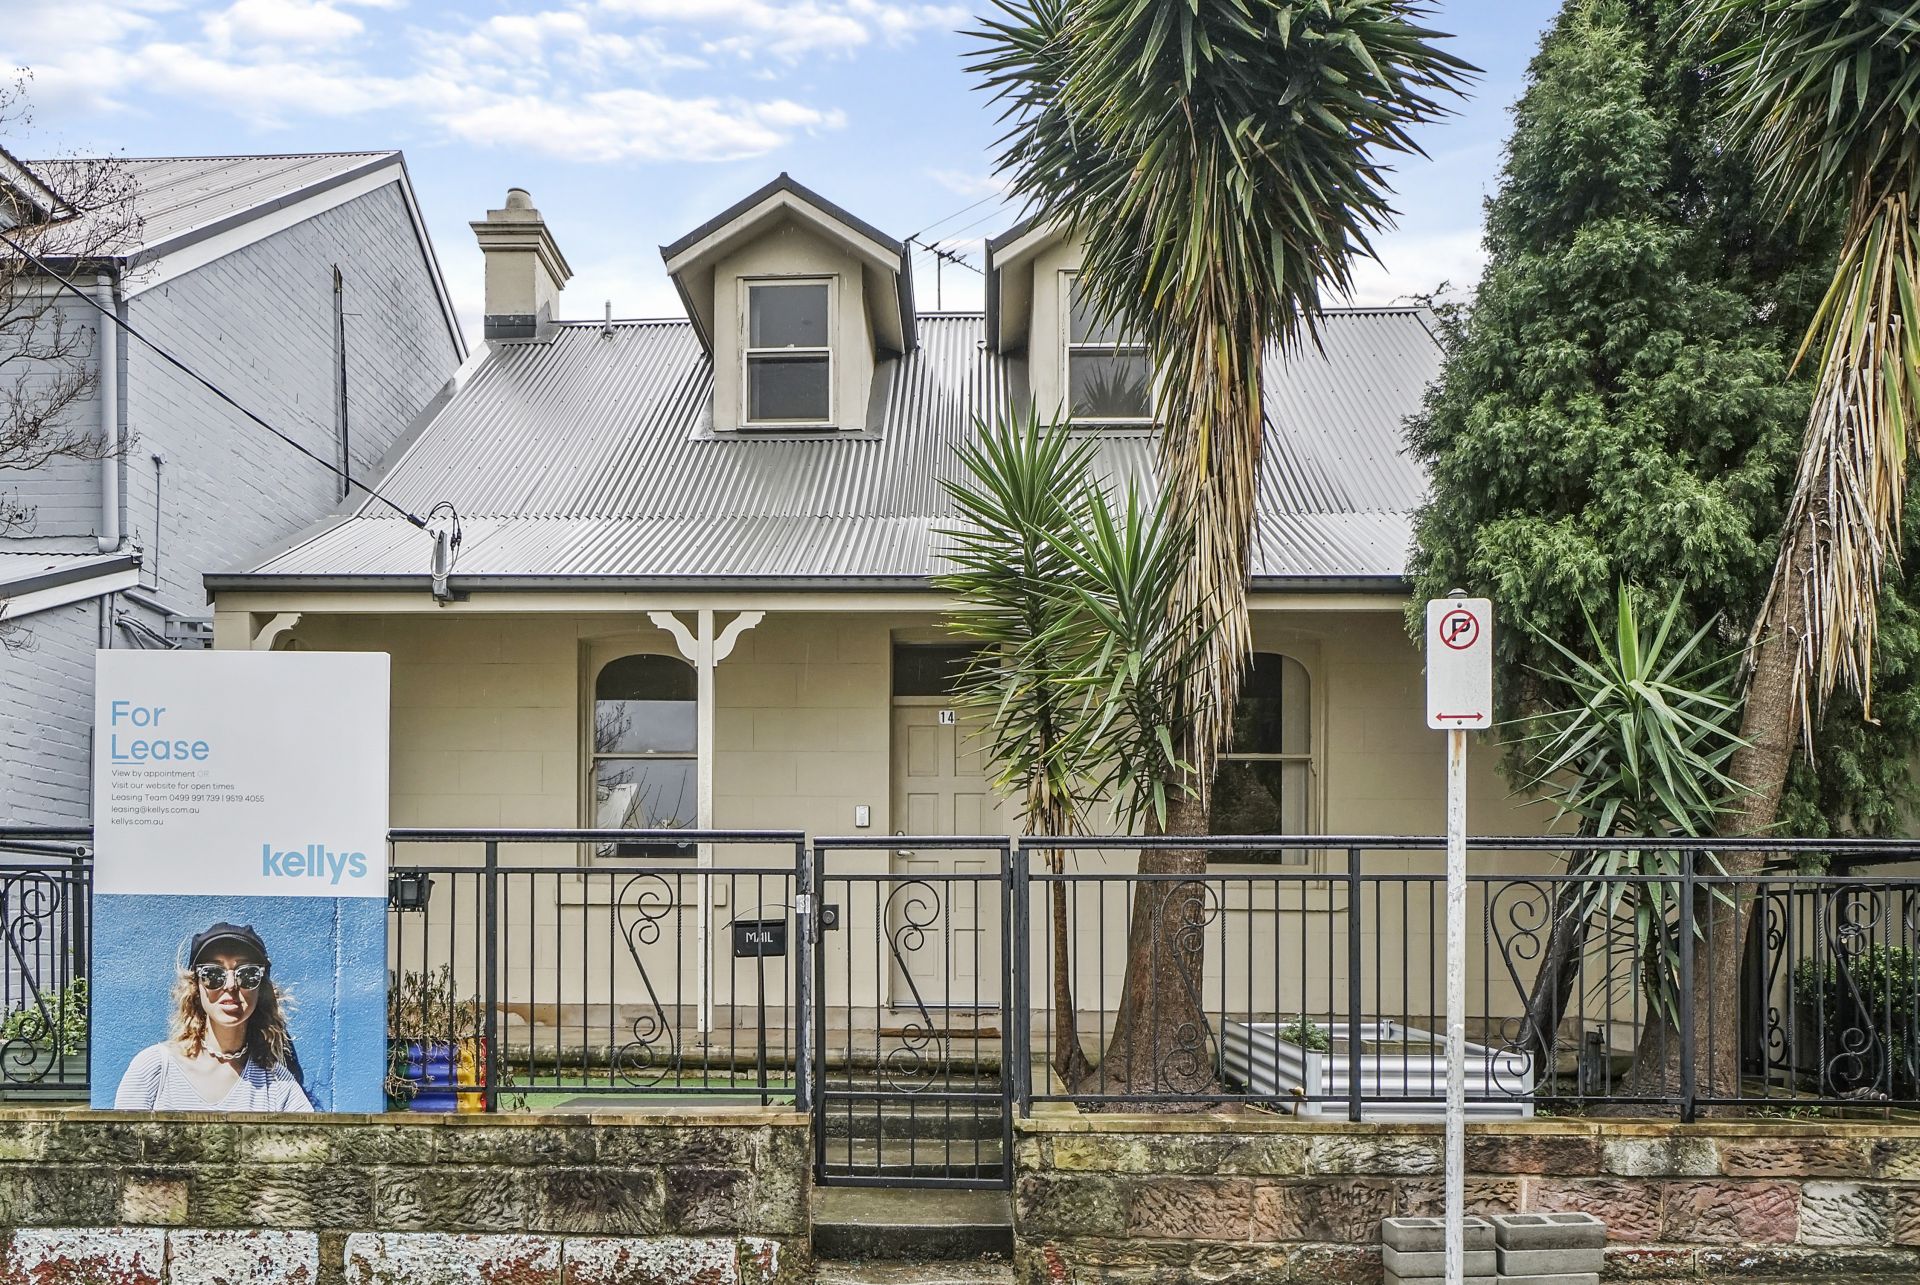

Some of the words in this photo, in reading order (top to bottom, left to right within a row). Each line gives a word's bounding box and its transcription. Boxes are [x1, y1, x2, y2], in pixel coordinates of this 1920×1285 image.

[1452, 618, 1471, 641] P
[111, 700, 166, 727] For
[941, 711, 954, 723] 14
[111, 733, 210, 761] Lease
[111, 769, 130, 777] View
[132, 769, 142, 778] by
[143, 769, 195, 778] appointment
[111, 781, 128, 789] Visit
[145, 781, 176, 789] website
[177, 781, 188, 789] for
[212, 782, 235, 790] times
[111, 793, 142, 802] Leasing
[144, 793, 167, 801] Team
[169, 793, 189, 802] 0499
[191, 794, 205, 802] 991
[206, 794, 220, 802] 739
[225, 794, 243, 802] 9519
[244, 794, 265, 803] 4055
[111, 805, 200, 814] leasing@kellys.com.au
[111, 817, 164, 826] kellys.com.au
[262, 844, 367, 885] kellys
[746, 931, 773, 943] MAIL
